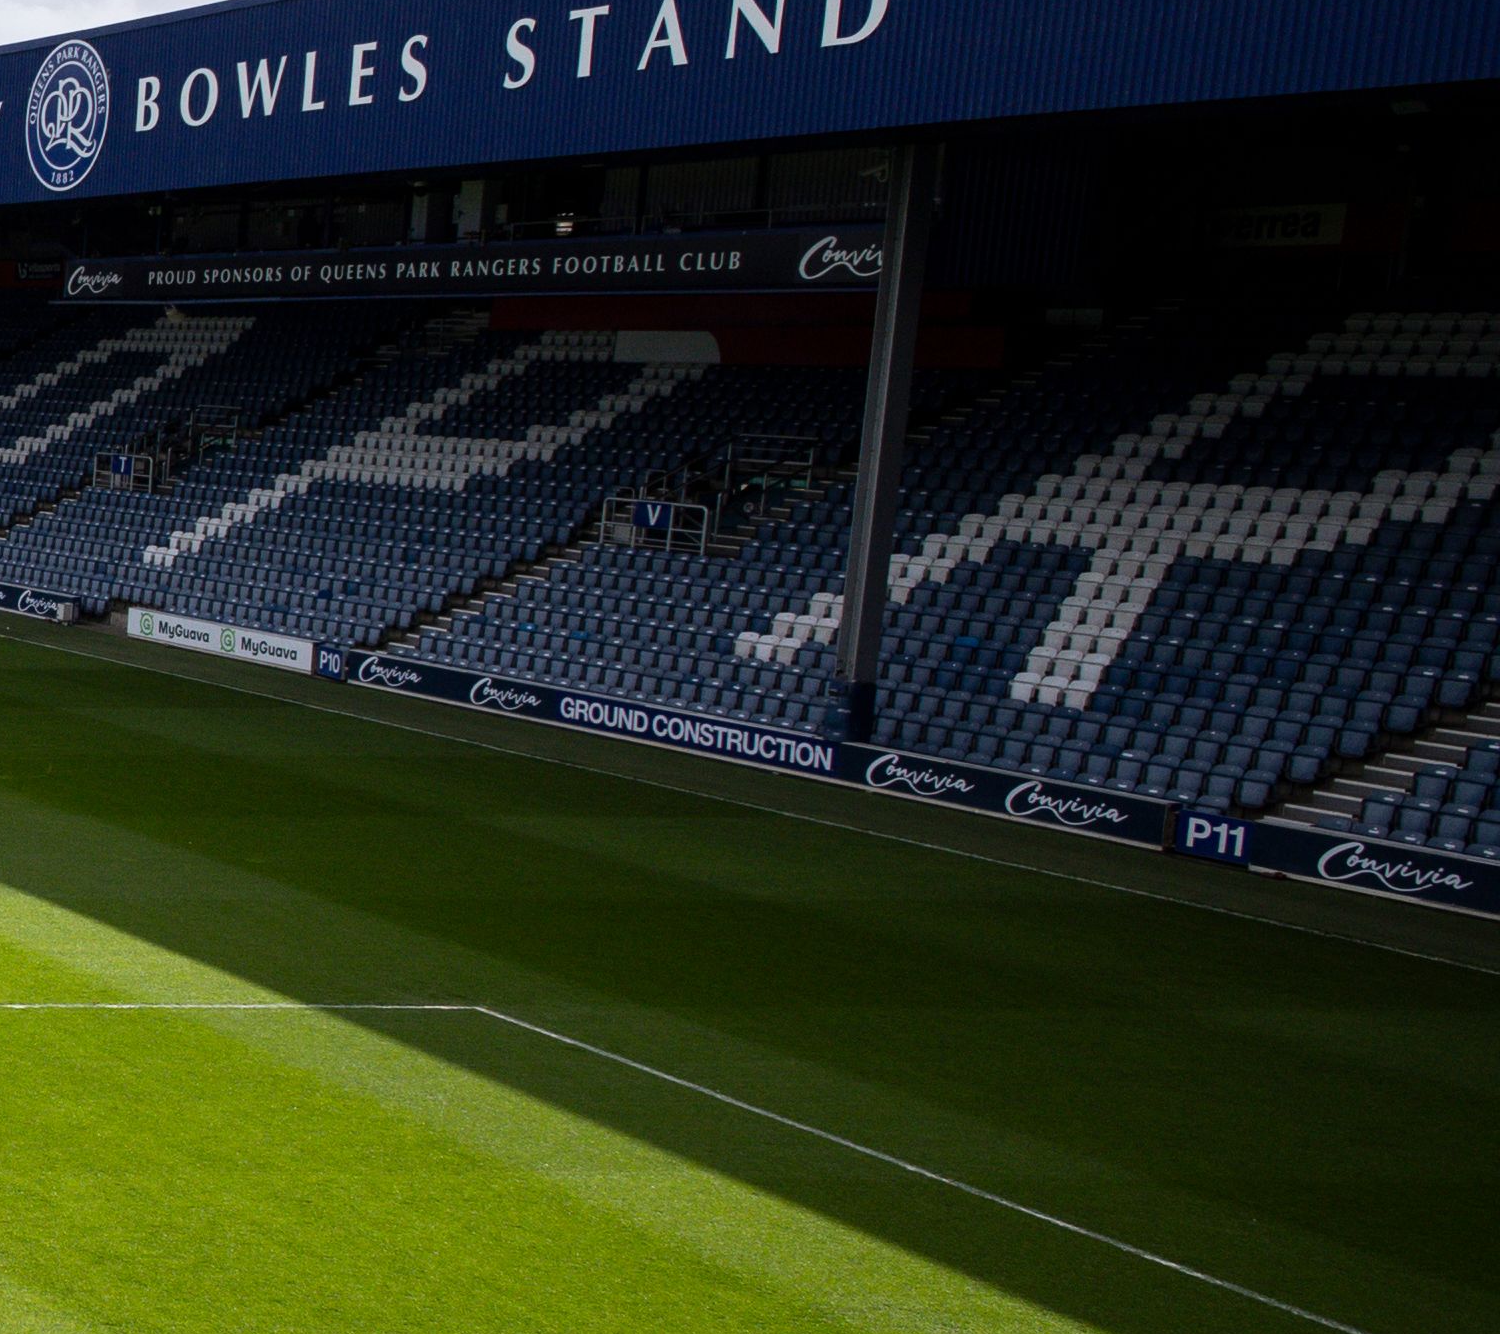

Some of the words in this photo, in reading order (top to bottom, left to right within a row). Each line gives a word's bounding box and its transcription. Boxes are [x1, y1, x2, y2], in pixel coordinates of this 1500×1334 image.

[30, 61, 56, 125] QUEENS
[56, 46, 80, 64] PARK
[81, 50, 107, 114] RANGERS
[134, 34, 429, 132] BOWLES
[51, 170, 75, 184] 1882
[67, 265, 123, 295] Convivia
[148, 270, 197, 286] PROUD
[203, 268, 284, 285] SPONSORS
[291, 266, 313, 282] OF
[320, 263, 387, 283] QUEENS
[396, 261, 443, 279] PARK
[450, 258, 542, 278] RANGERS
[551, 253, 667, 275] FOOTBALL
[678, 251, 741, 271] CLUB
[116, 457, 129, 473] T
[645, 503, 661, 526] V
[18, 589, 58, 615] Convivia
[158, 620, 210, 644] MyGuava
[241, 636, 298, 661] MyGuava
[319, 650, 341, 674] P10
[358, 656, 422, 687] Convivia
[469, 677, 542, 711] Convivia
[560, 697, 648, 734] GROUND
[652, 713, 834, 771] CONSTRUCTION
[865, 753, 975, 796] Convivia
[1004, 780, 1129, 826] Convivia
[1186, 817, 1246, 858] P11
[1318, 841, 1474, 893] Convivia
